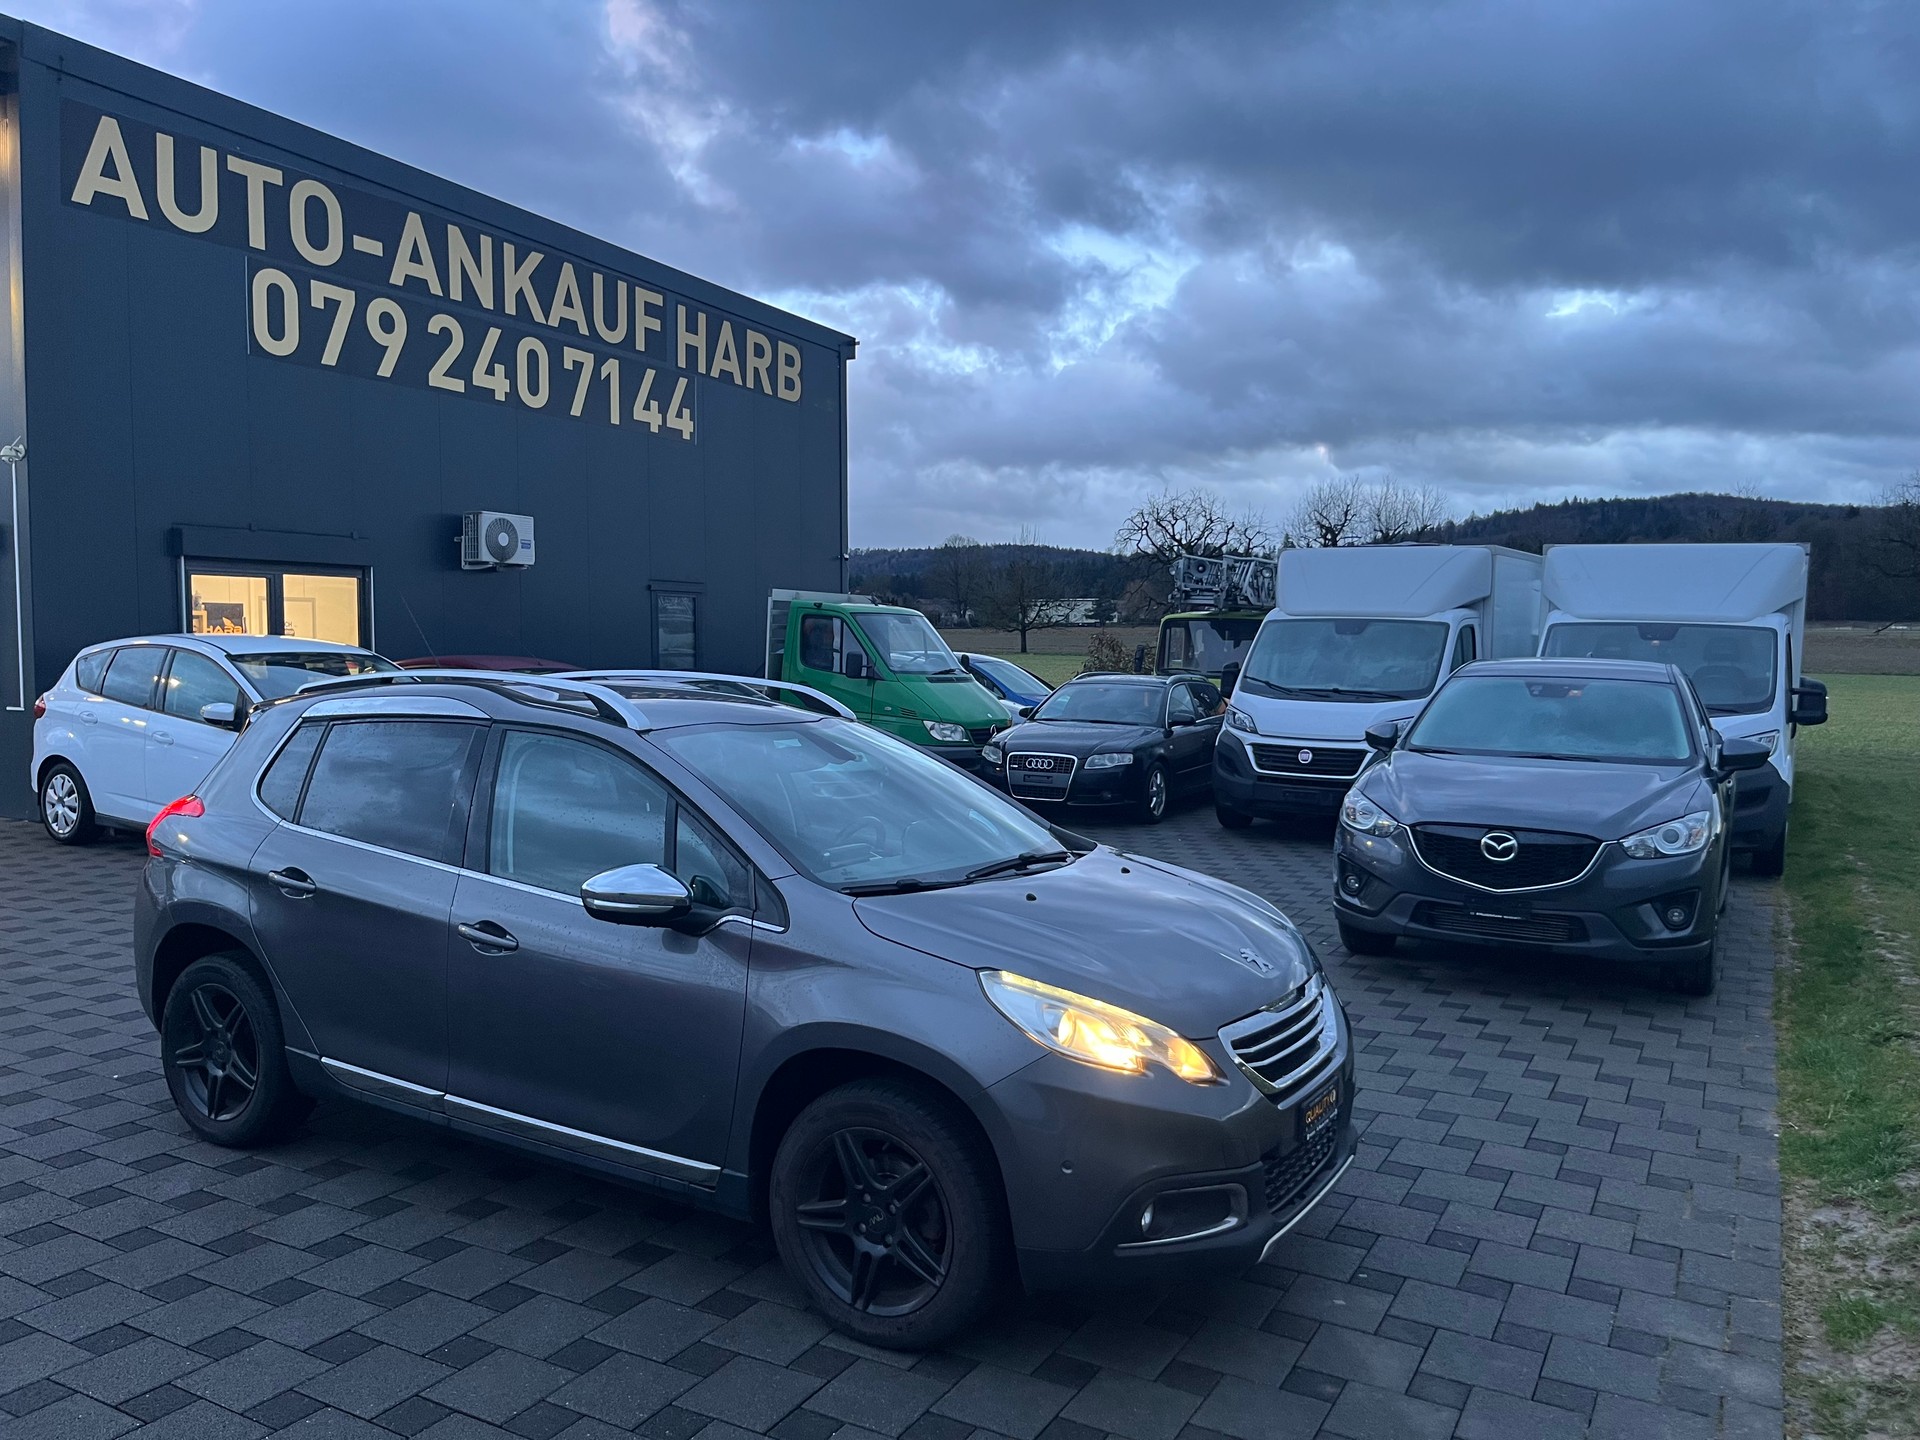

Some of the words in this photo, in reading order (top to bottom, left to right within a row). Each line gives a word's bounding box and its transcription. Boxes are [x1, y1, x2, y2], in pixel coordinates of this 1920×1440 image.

[71, 115, 664, 351] AUTO-ANKAUF
[677, 304, 802, 402] HARB
[252, 268, 408, 378] 079
[427, 313, 550, 409] 240
